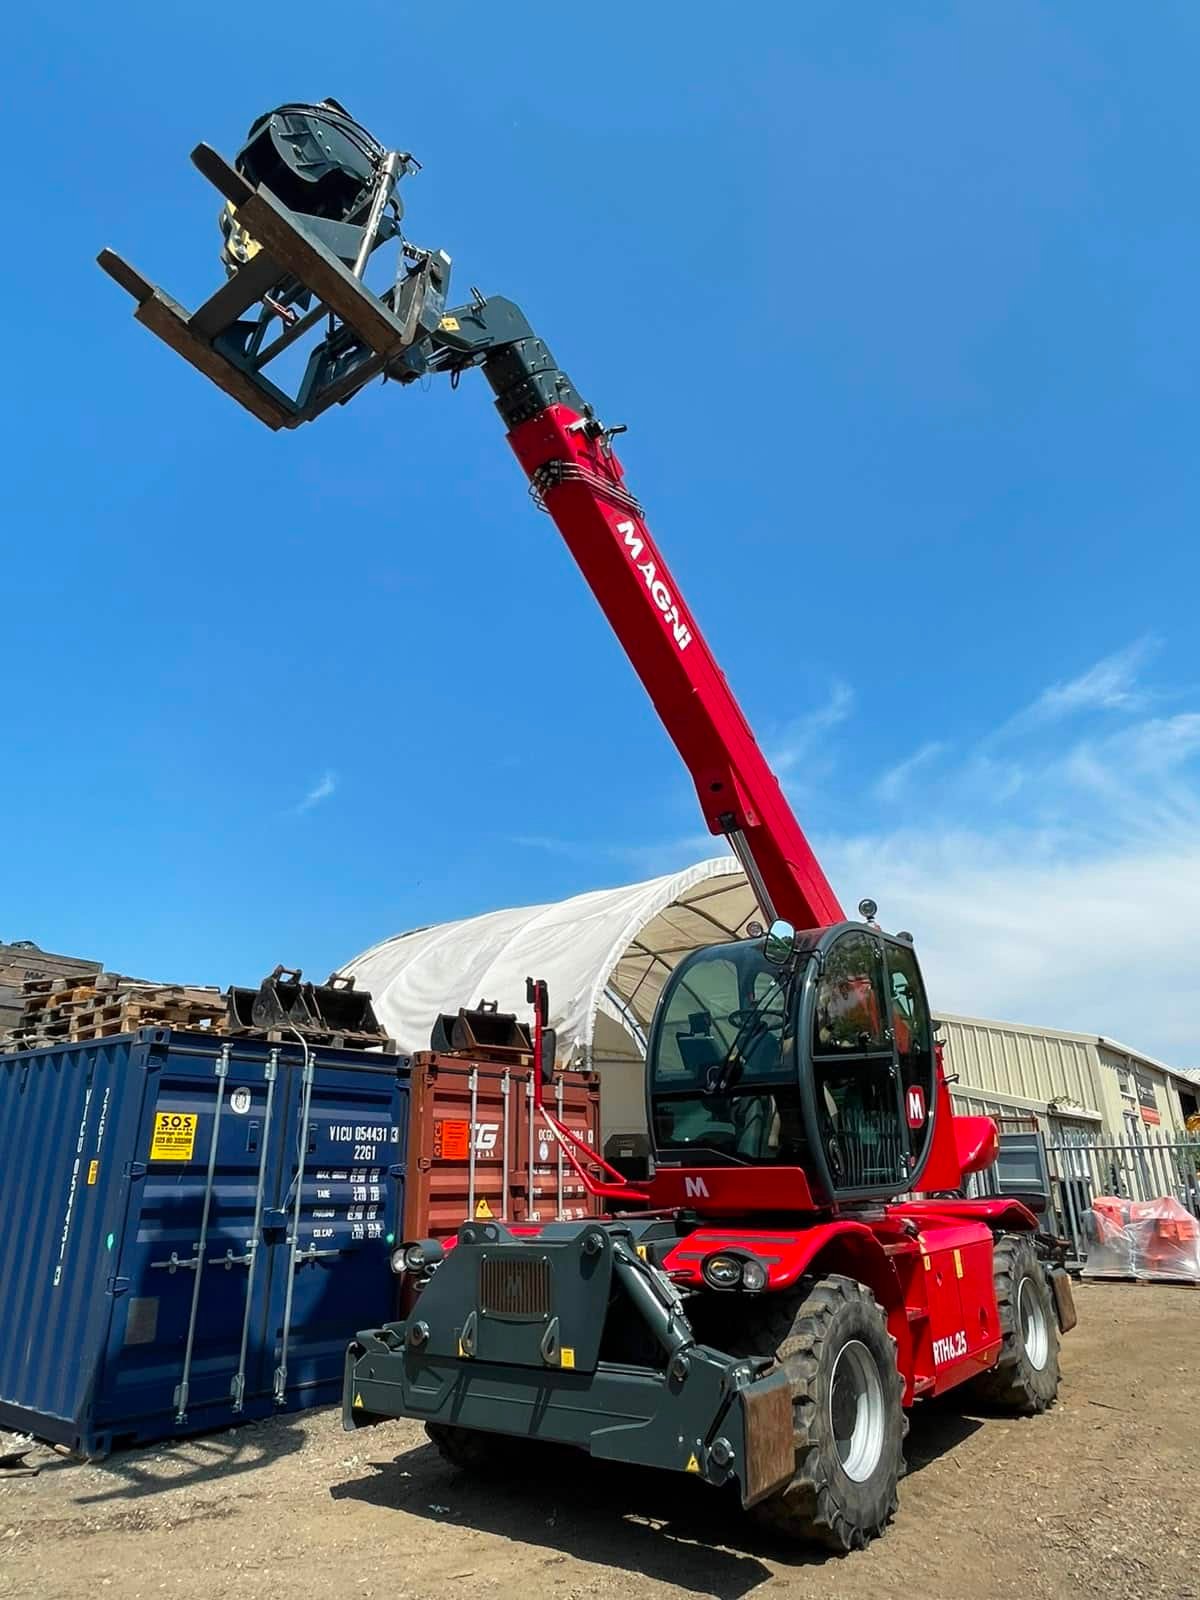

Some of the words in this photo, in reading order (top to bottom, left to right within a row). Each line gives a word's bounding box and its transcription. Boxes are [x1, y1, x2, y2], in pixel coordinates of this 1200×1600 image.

[616, 520, 692, 651] MAGNI
[909, 1092, 924, 1119] M
[161, 1116, 192, 1127] SOS
[329, 1126, 352, 1141] VICU
[355, 1127, 387, 1141] 054431
[390, 1127, 399, 1143] 3
[685, 1176, 710, 1198] M
[932, 1330, 967, 1366] RTH6.25
